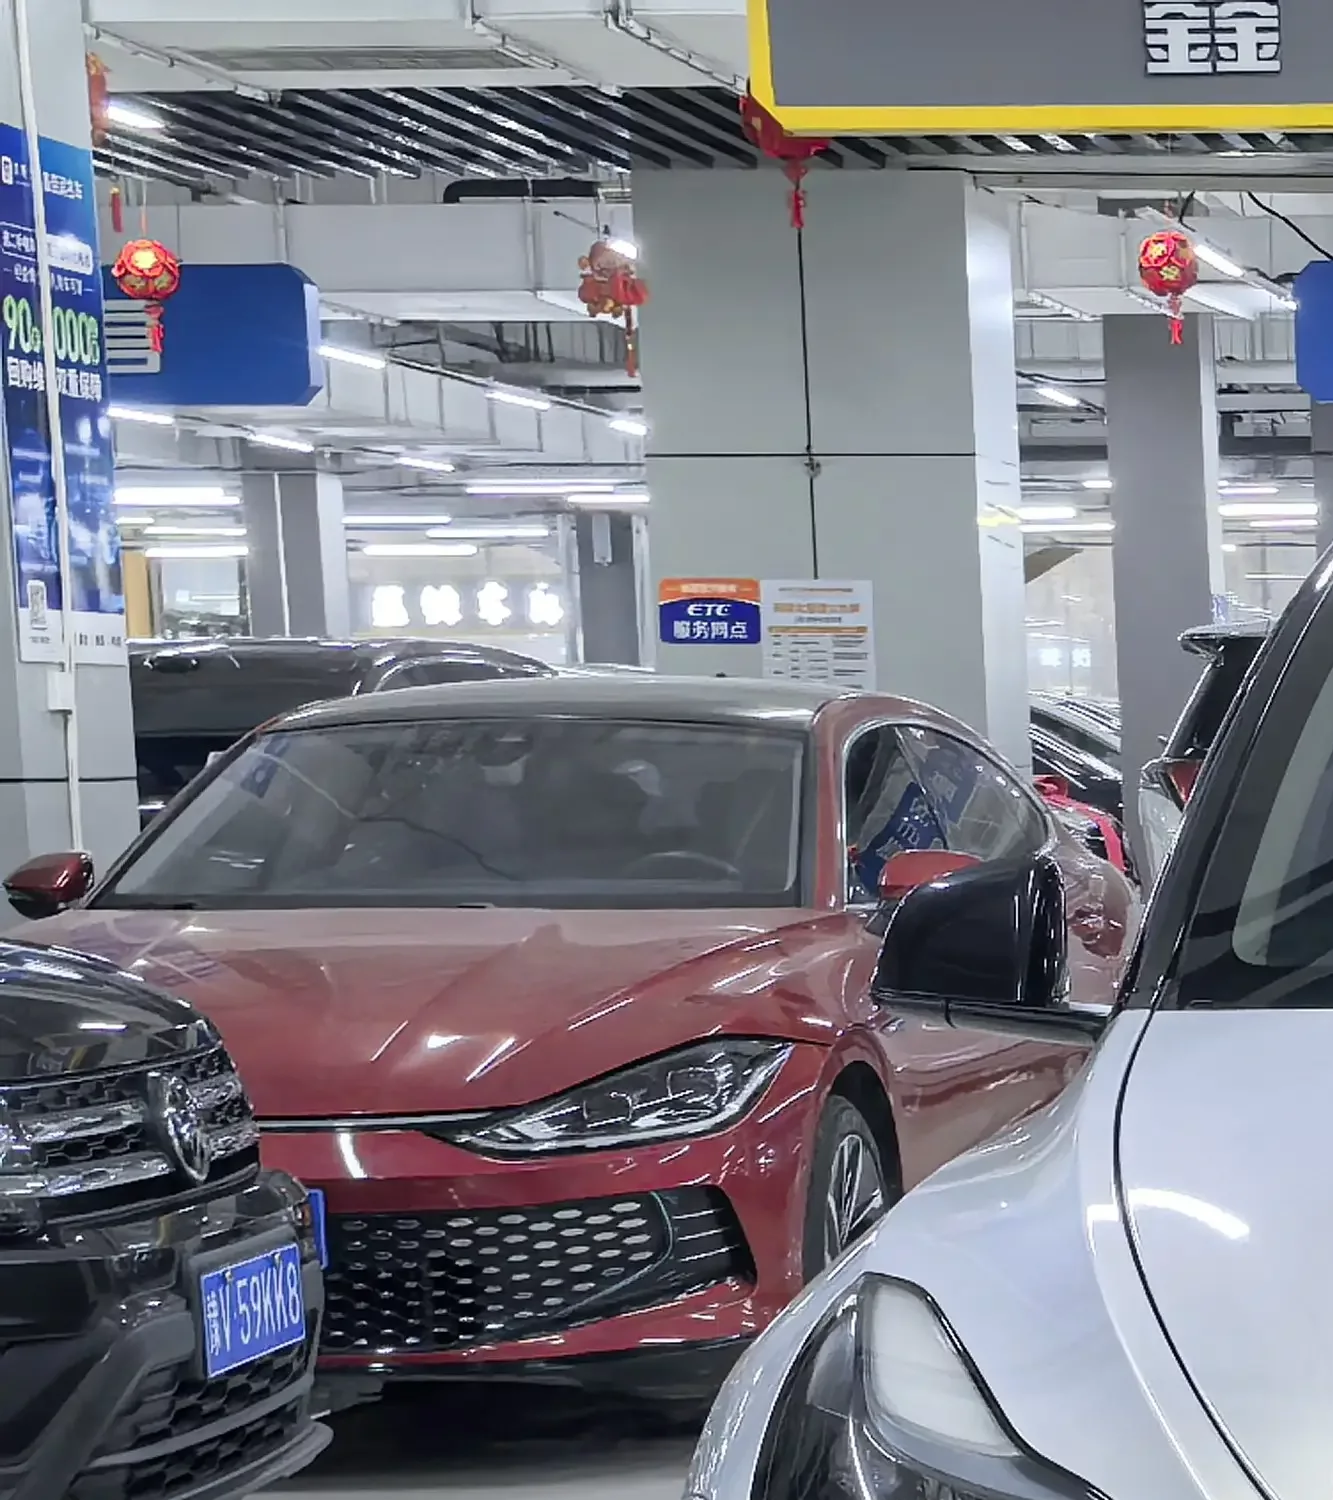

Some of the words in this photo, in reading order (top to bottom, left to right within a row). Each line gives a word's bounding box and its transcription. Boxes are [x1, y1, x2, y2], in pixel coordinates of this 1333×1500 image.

[687, 604, 731, 617] ETC
[673, 620, 748, 640] 服务网点
